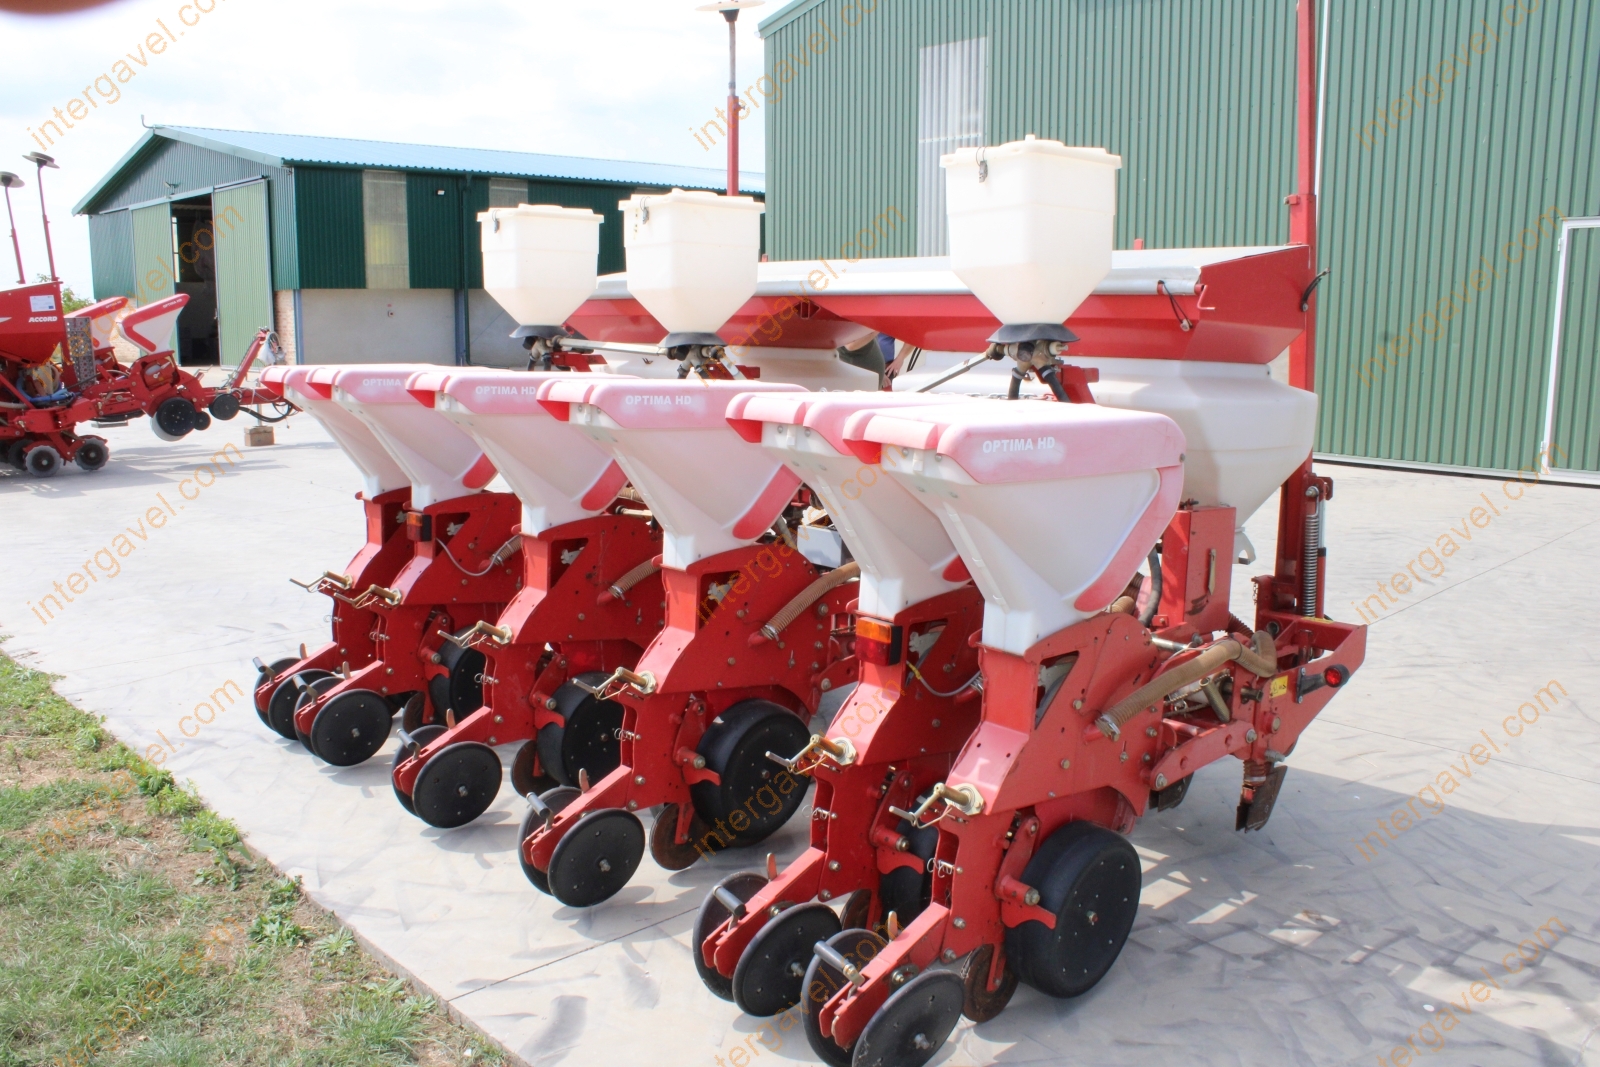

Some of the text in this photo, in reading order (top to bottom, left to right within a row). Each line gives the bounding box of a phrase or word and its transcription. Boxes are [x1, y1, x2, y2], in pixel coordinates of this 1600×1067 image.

[362, 378, 402, 386] OPTIMA
[475, 386, 536, 395] OPTIMA HD
[625, 395, 692, 405] OPTIMA HD
[982, 436, 1056, 454] OPTIMA HD
